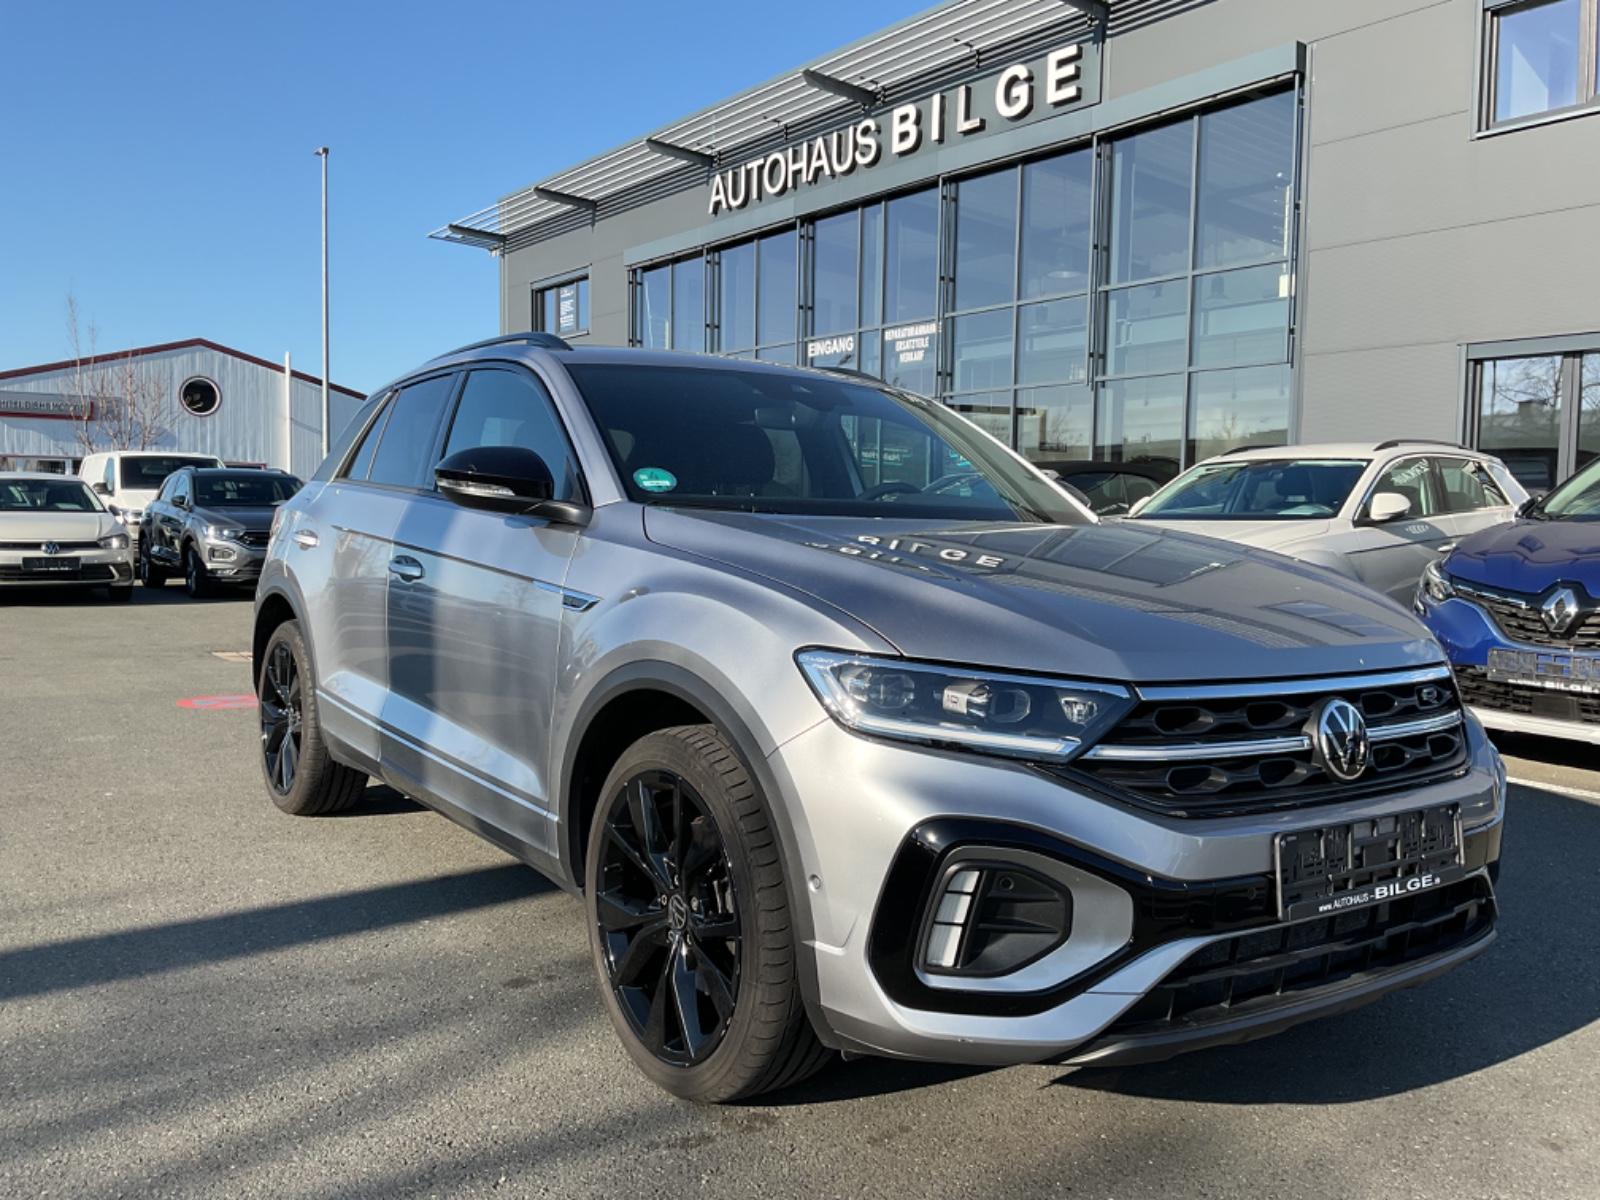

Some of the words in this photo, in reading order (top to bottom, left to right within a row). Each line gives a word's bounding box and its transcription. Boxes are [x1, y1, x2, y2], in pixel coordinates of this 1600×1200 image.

[708, 118, 881, 216] AUTOHAUS
[891, 43, 1082, 155] BILGE
[808, 336, 854, 358] EINGANG
